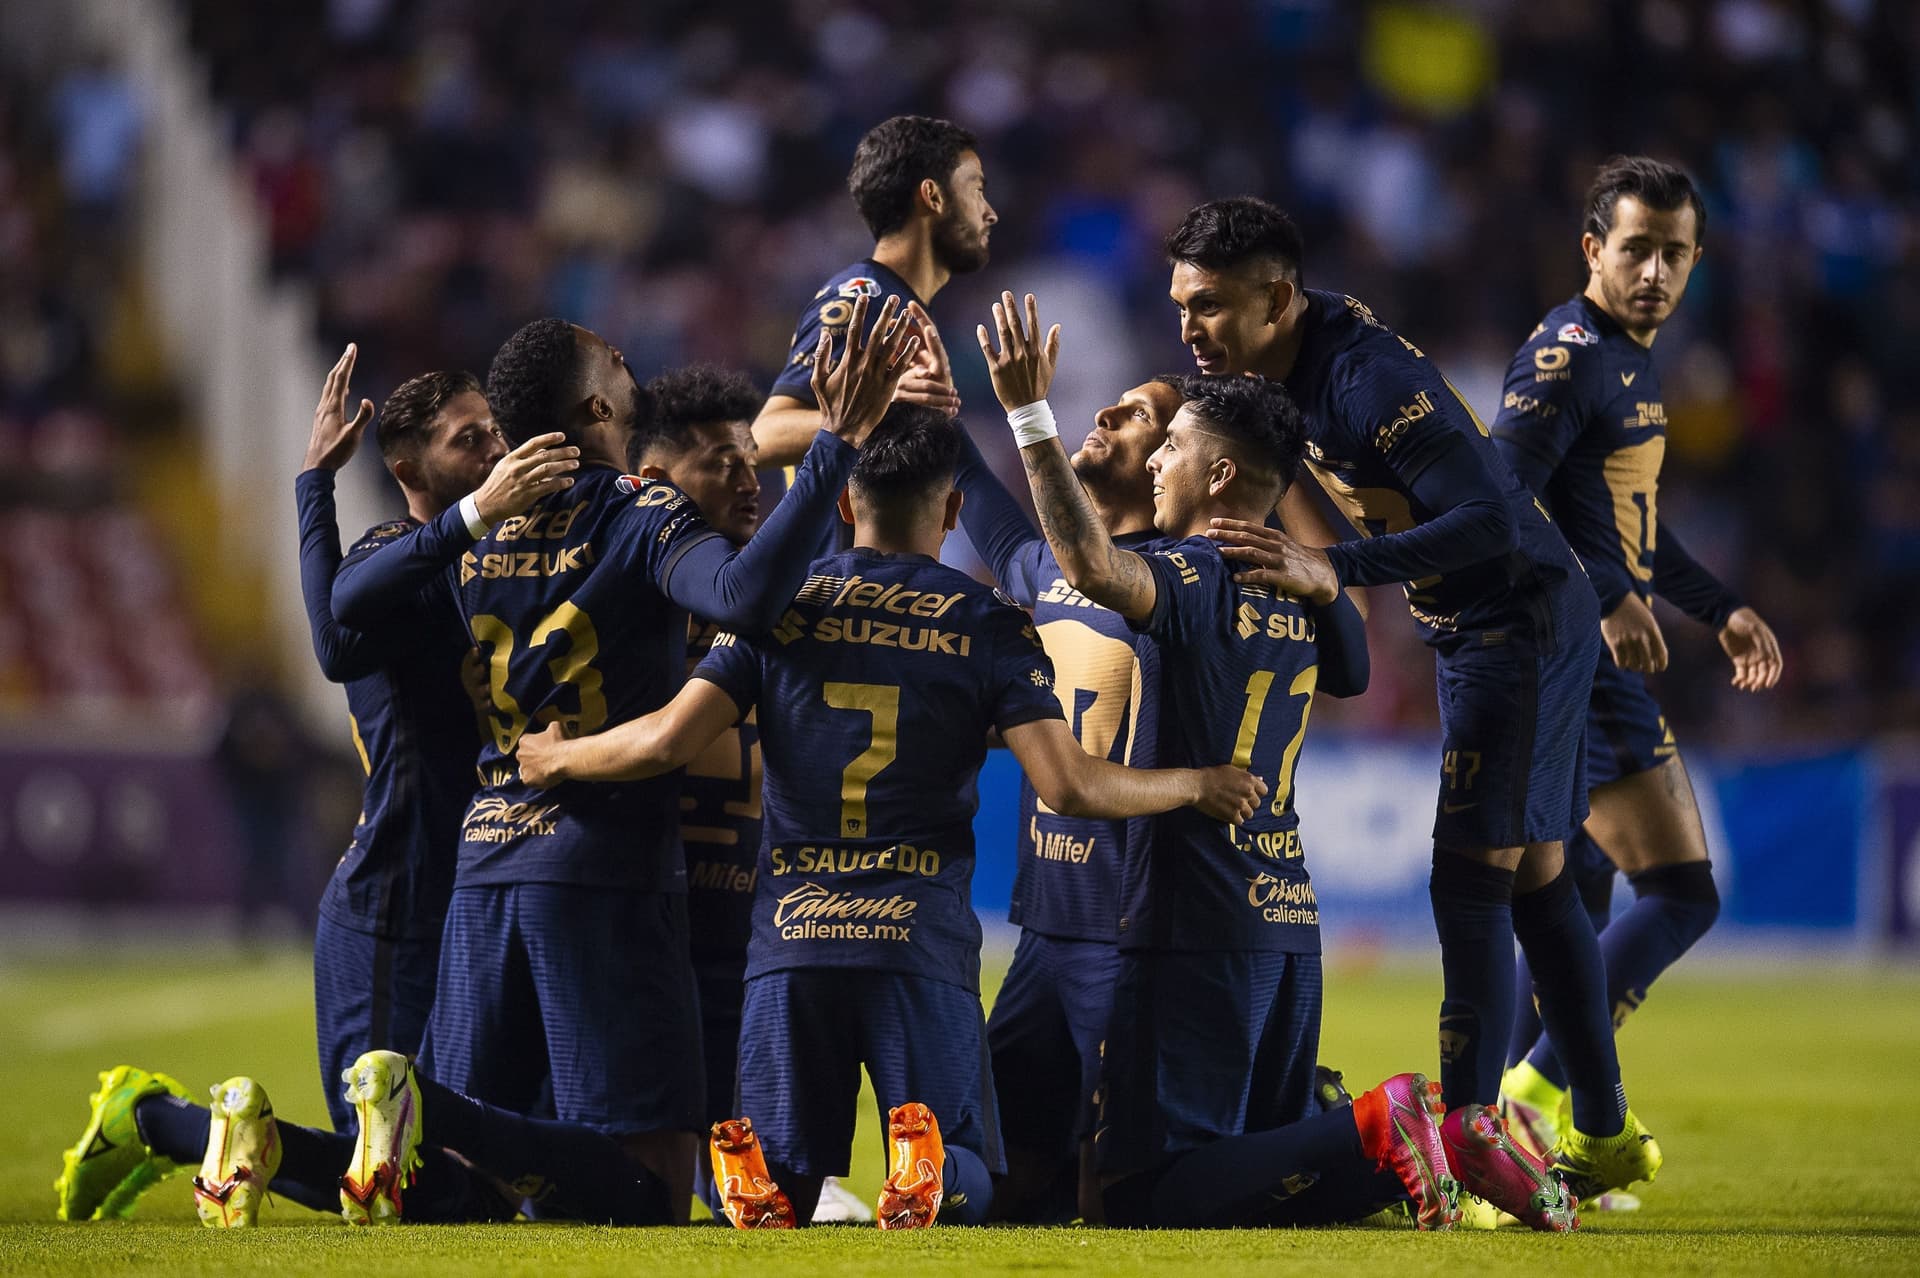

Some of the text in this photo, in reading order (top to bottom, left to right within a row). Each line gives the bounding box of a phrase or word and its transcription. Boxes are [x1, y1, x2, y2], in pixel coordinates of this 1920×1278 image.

[481, 542, 594, 579] SUZUKI
[832, 575, 967, 619] telcel
[812, 616, 971, 657] SUZUKI
[470, 600, 608, 755] 33
[823, 681, 901, 839] 7
[1444, 750, 1480, 790] 47
[796, 844, 941, 877] SAUCEDO
[1044, 831, 1096, 864] Mifel
[690, 862, 758, 893] Mifel
[773, 881, 918, 928] Caliente
[780, 920, 911, 943] caliente.mx
